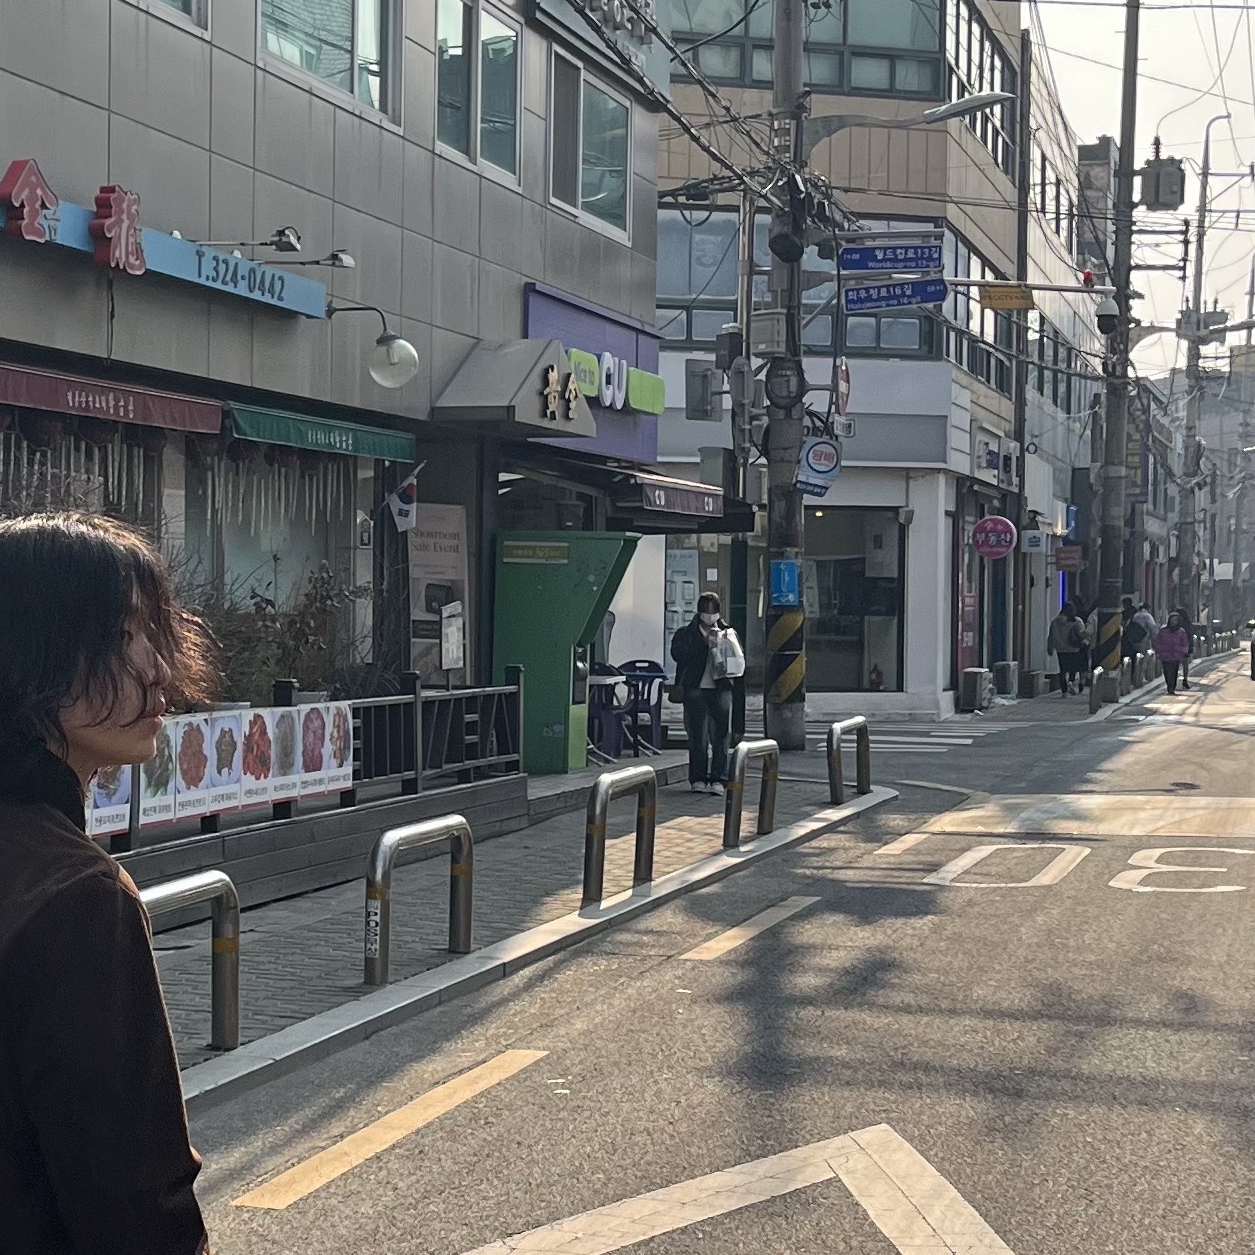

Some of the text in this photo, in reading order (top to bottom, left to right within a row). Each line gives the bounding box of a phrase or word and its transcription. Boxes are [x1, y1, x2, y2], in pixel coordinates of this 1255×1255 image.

[874, 246, 940, 260] 월드컵로13길
[196, 250, 285, 301] T.324-0442
[599, 351, 627, 410] CU
[974, 531, 1012, 547] 부동산
